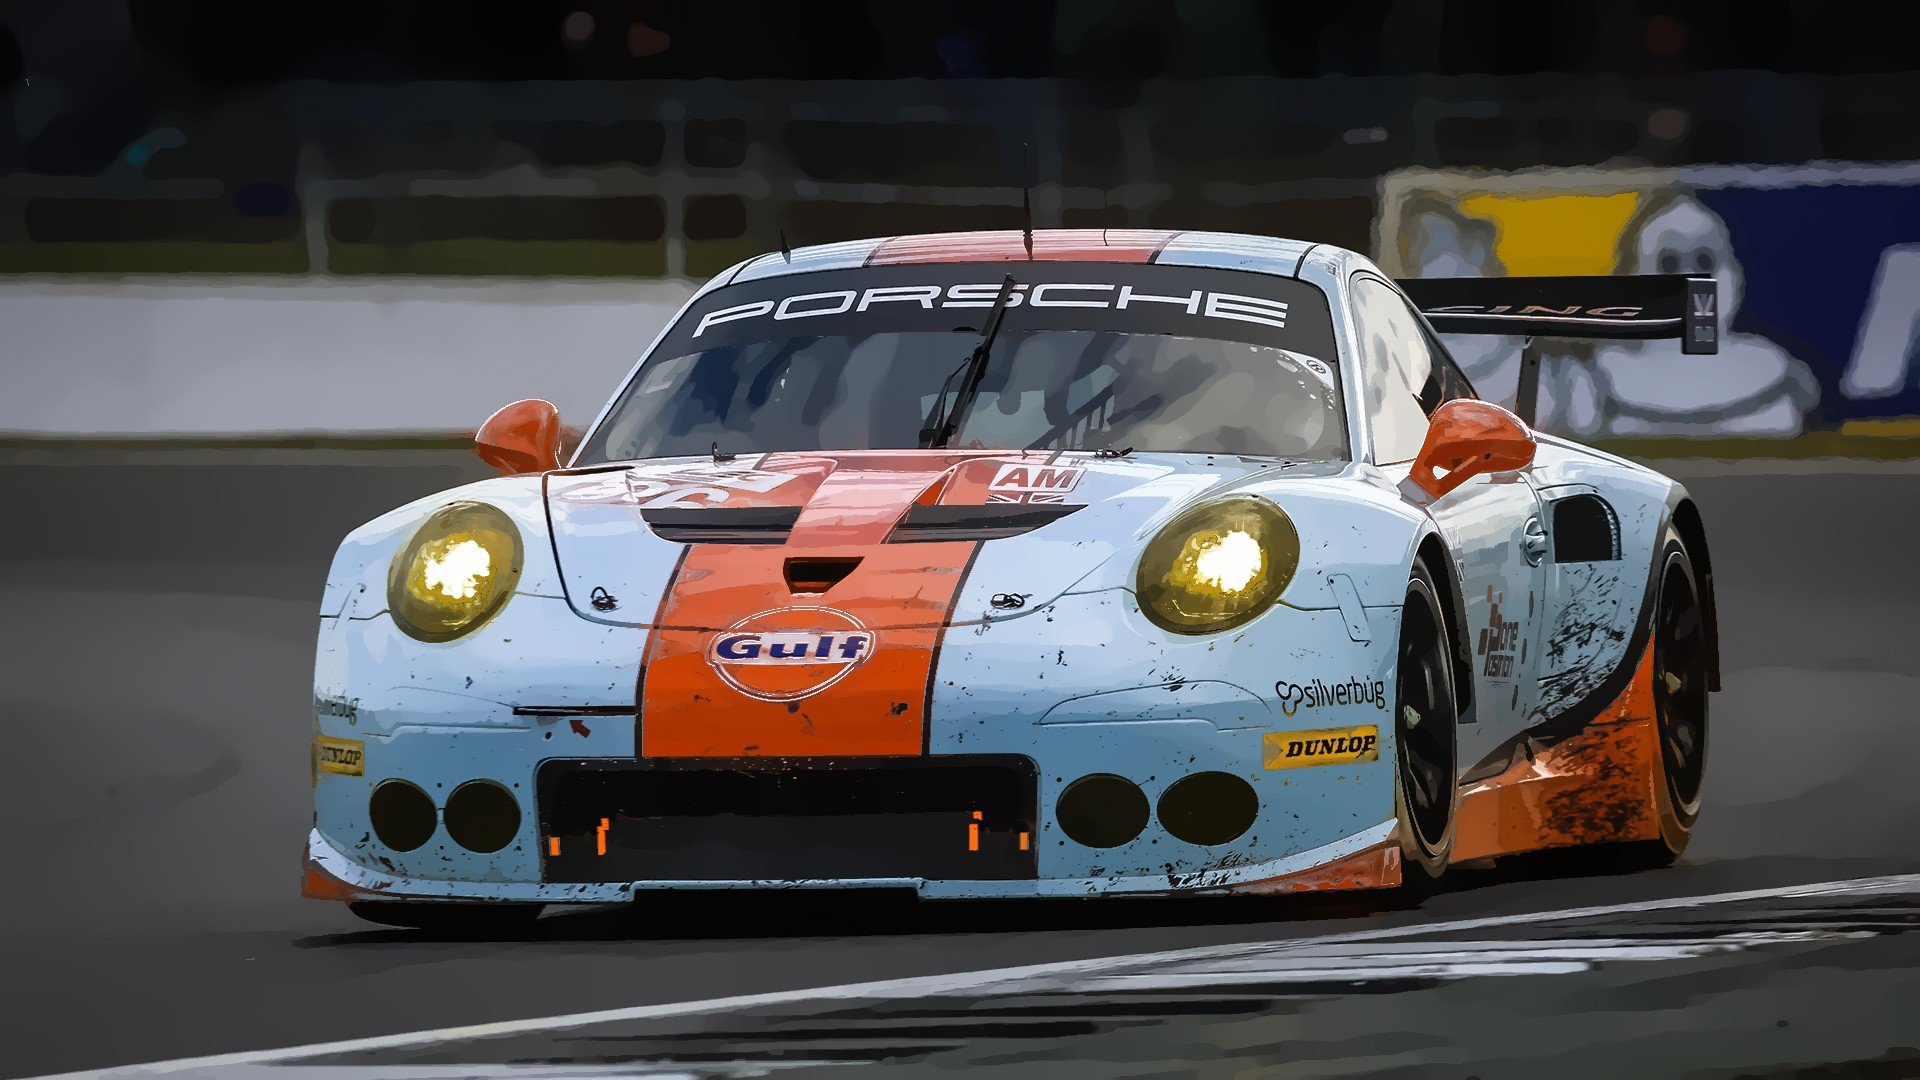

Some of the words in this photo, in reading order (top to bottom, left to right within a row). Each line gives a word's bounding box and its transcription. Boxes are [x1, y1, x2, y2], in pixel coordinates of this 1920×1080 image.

[692, 283, 1288, 338] PORSCHE
[994, 468, 1078, 488] AM
[717, 635, 868, 659] Gulf
[1304, 676, 1385, 709] silverbug
[1286, 735, 1376, 758] DUNLOP
